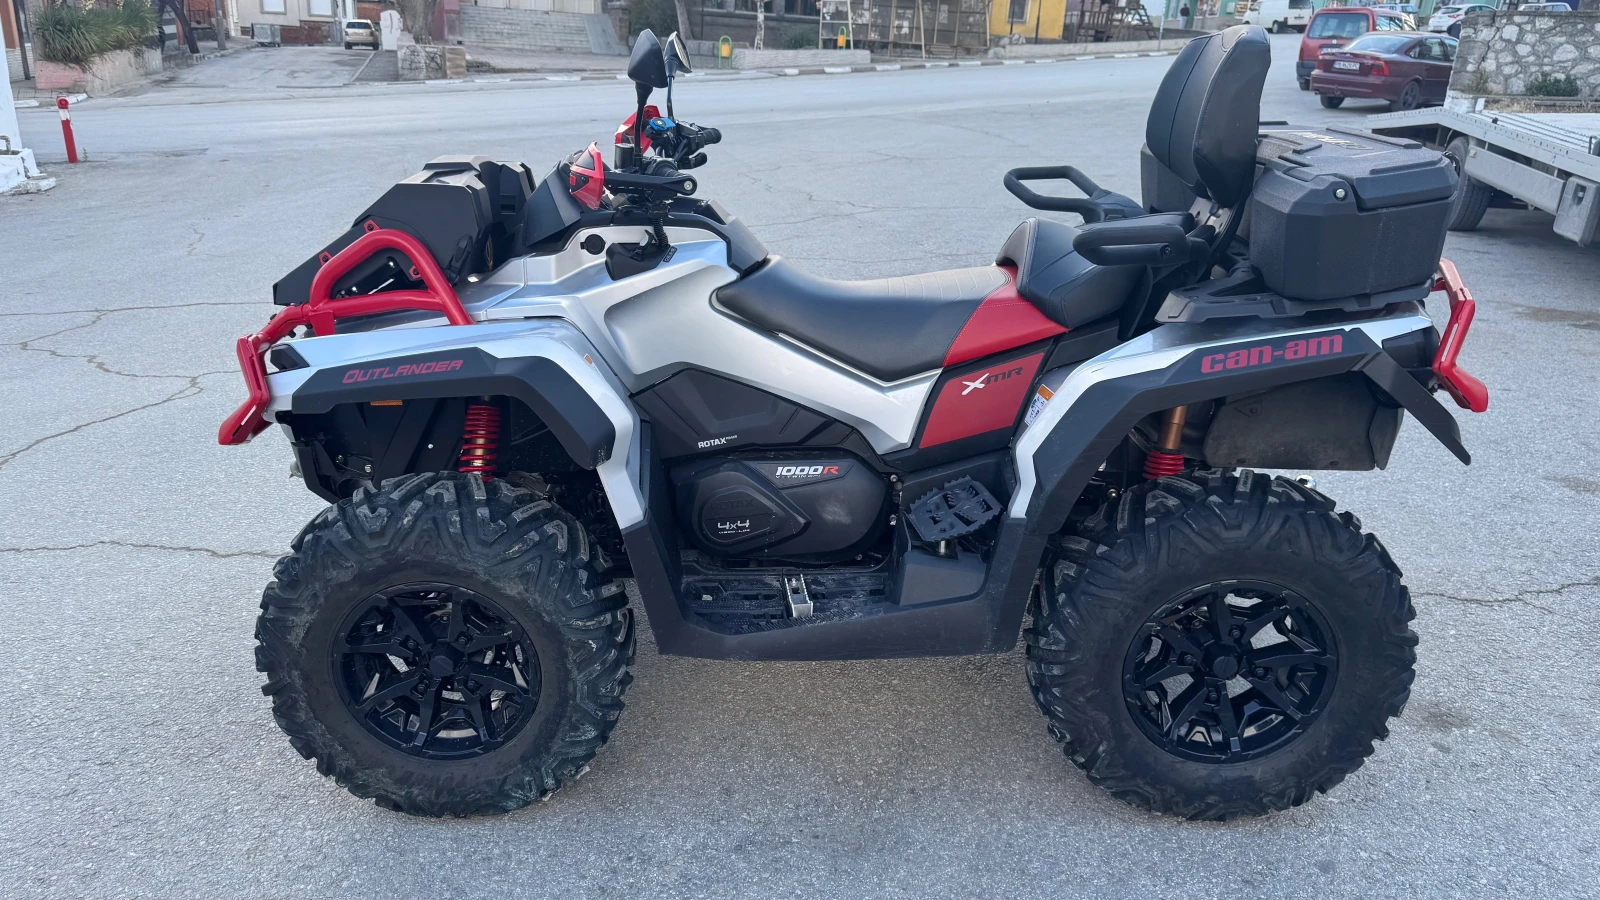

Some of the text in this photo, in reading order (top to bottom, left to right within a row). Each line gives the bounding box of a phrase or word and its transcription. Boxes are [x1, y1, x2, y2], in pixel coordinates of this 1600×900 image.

[1201, 334, 1343, 374] can-am
[342, 359, 464, 384] OUTLANDER
[698, 437, 727, 449] ROTAX
[775, 465, 839, 476] 1000R
[717, 519, 750, 530] 4x4
